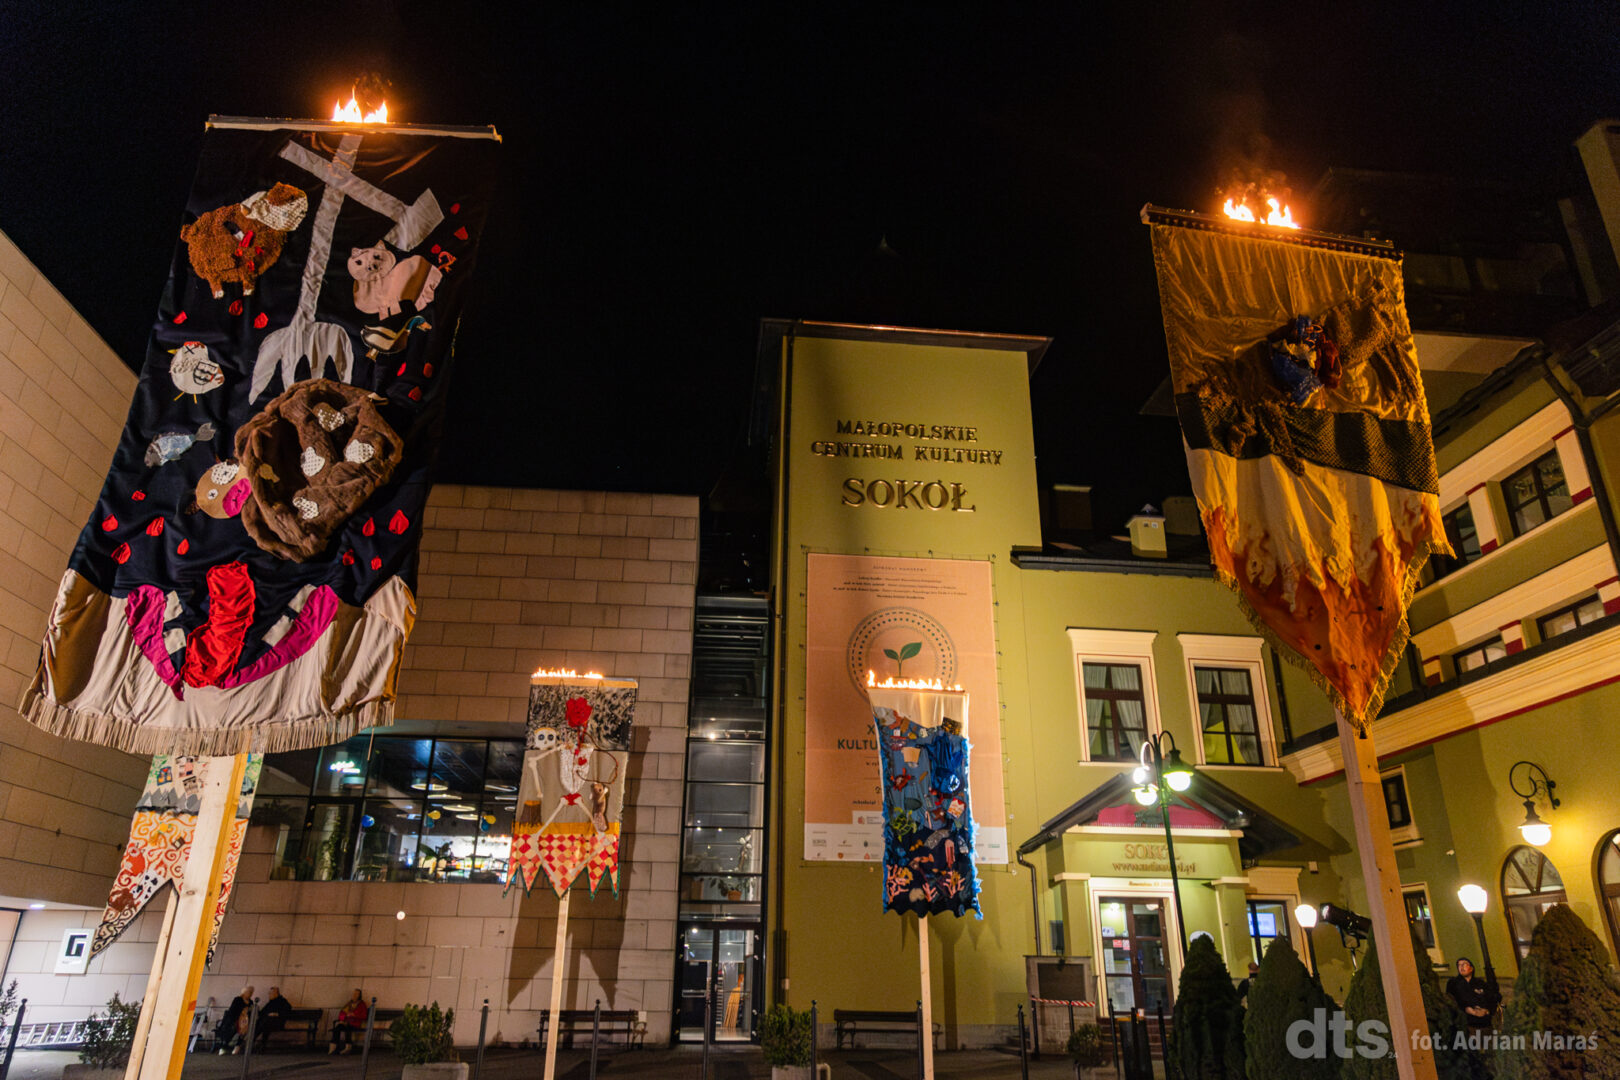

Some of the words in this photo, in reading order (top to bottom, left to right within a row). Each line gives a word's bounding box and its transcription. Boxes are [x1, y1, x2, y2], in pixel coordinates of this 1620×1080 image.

[837, 420, 977, 442] MAŁOPOLSKIE
[811, 440, 903, 460] CENTRUM
[914, 445, 1003, 465] KULTURY
[841, 478, 976, 513] SOKÓŁ
[1124, 843, 1181, 860] SOKÓ
